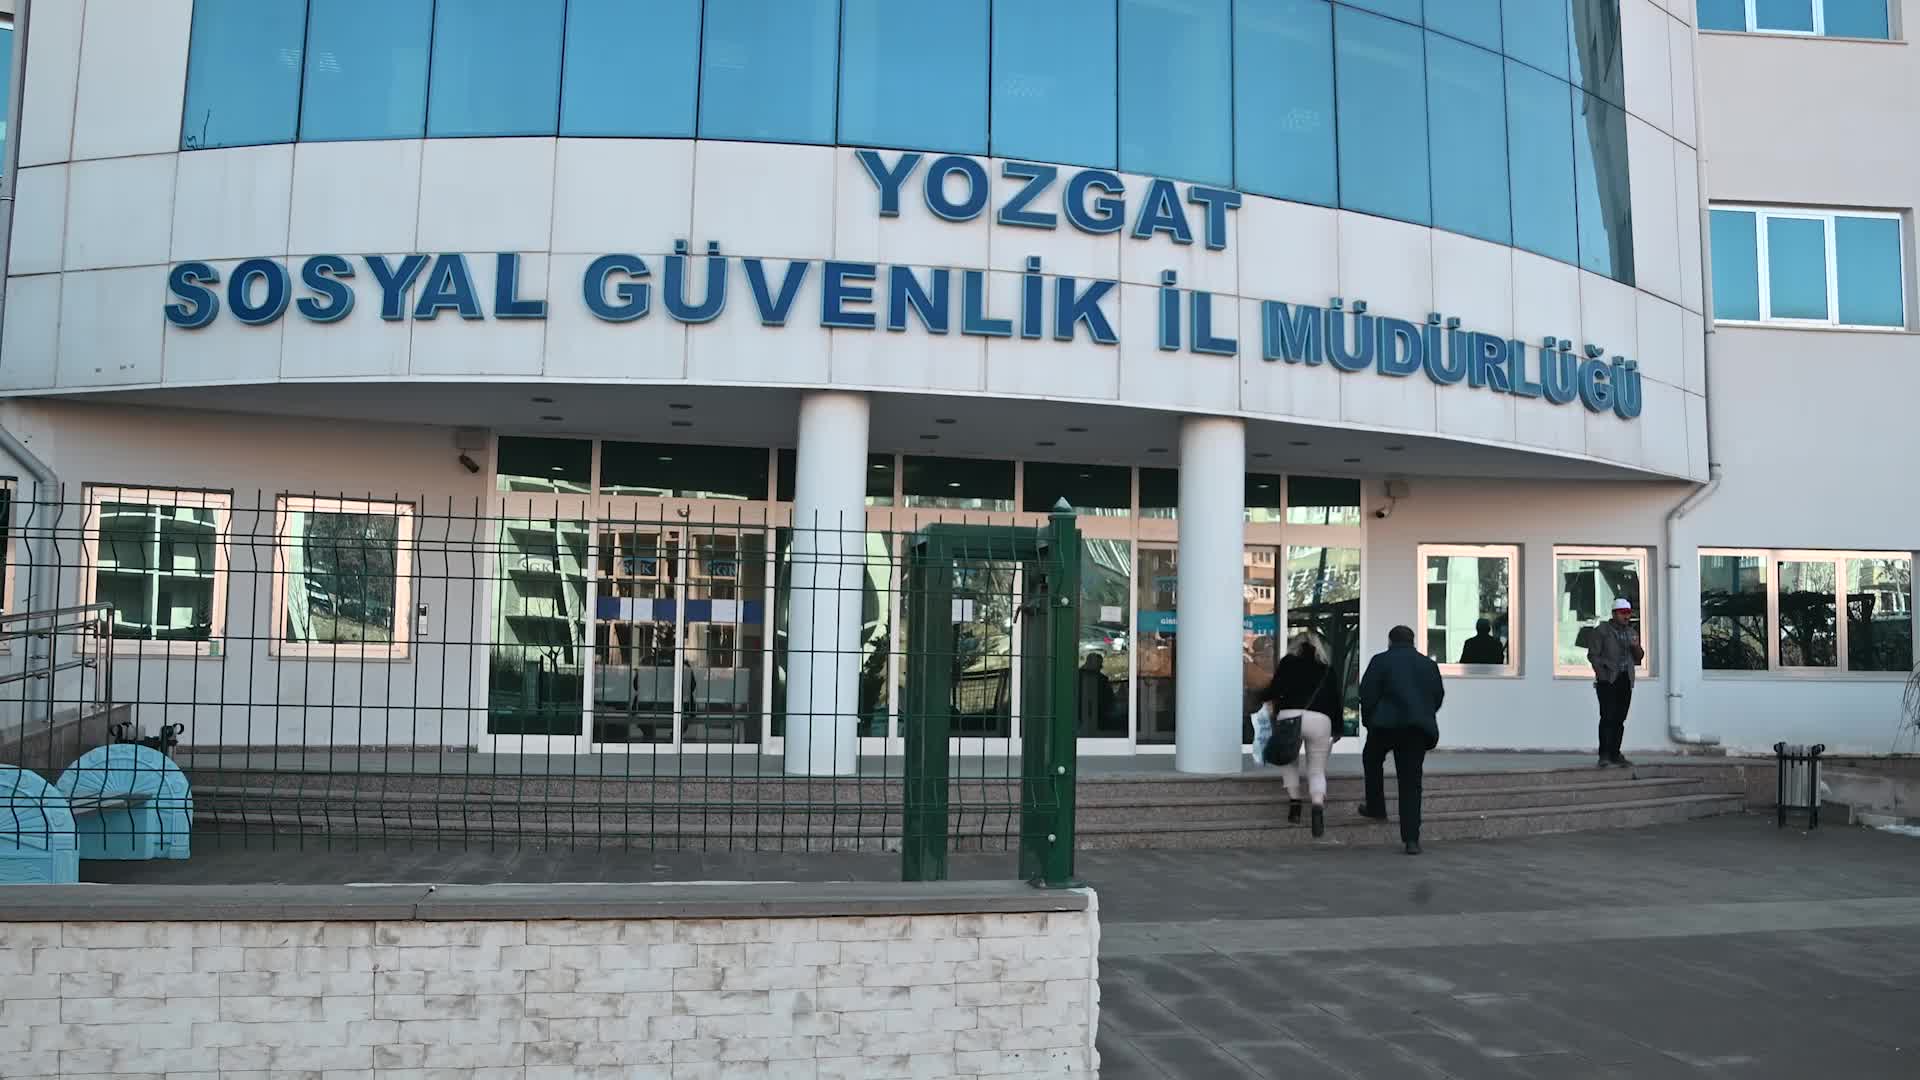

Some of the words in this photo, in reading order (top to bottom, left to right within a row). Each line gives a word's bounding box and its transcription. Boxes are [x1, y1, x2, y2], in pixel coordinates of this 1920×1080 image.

[855, 149, 1241, 250] YOZGAT
[164, 252, 548, 329] SOSYAL
[583, 239, 1120, 345] GÜVENLİK
[1158, 269, 1238, 356] İL
[1262, 297, 1642, 419] MÜDÜRLÜĞÜ
